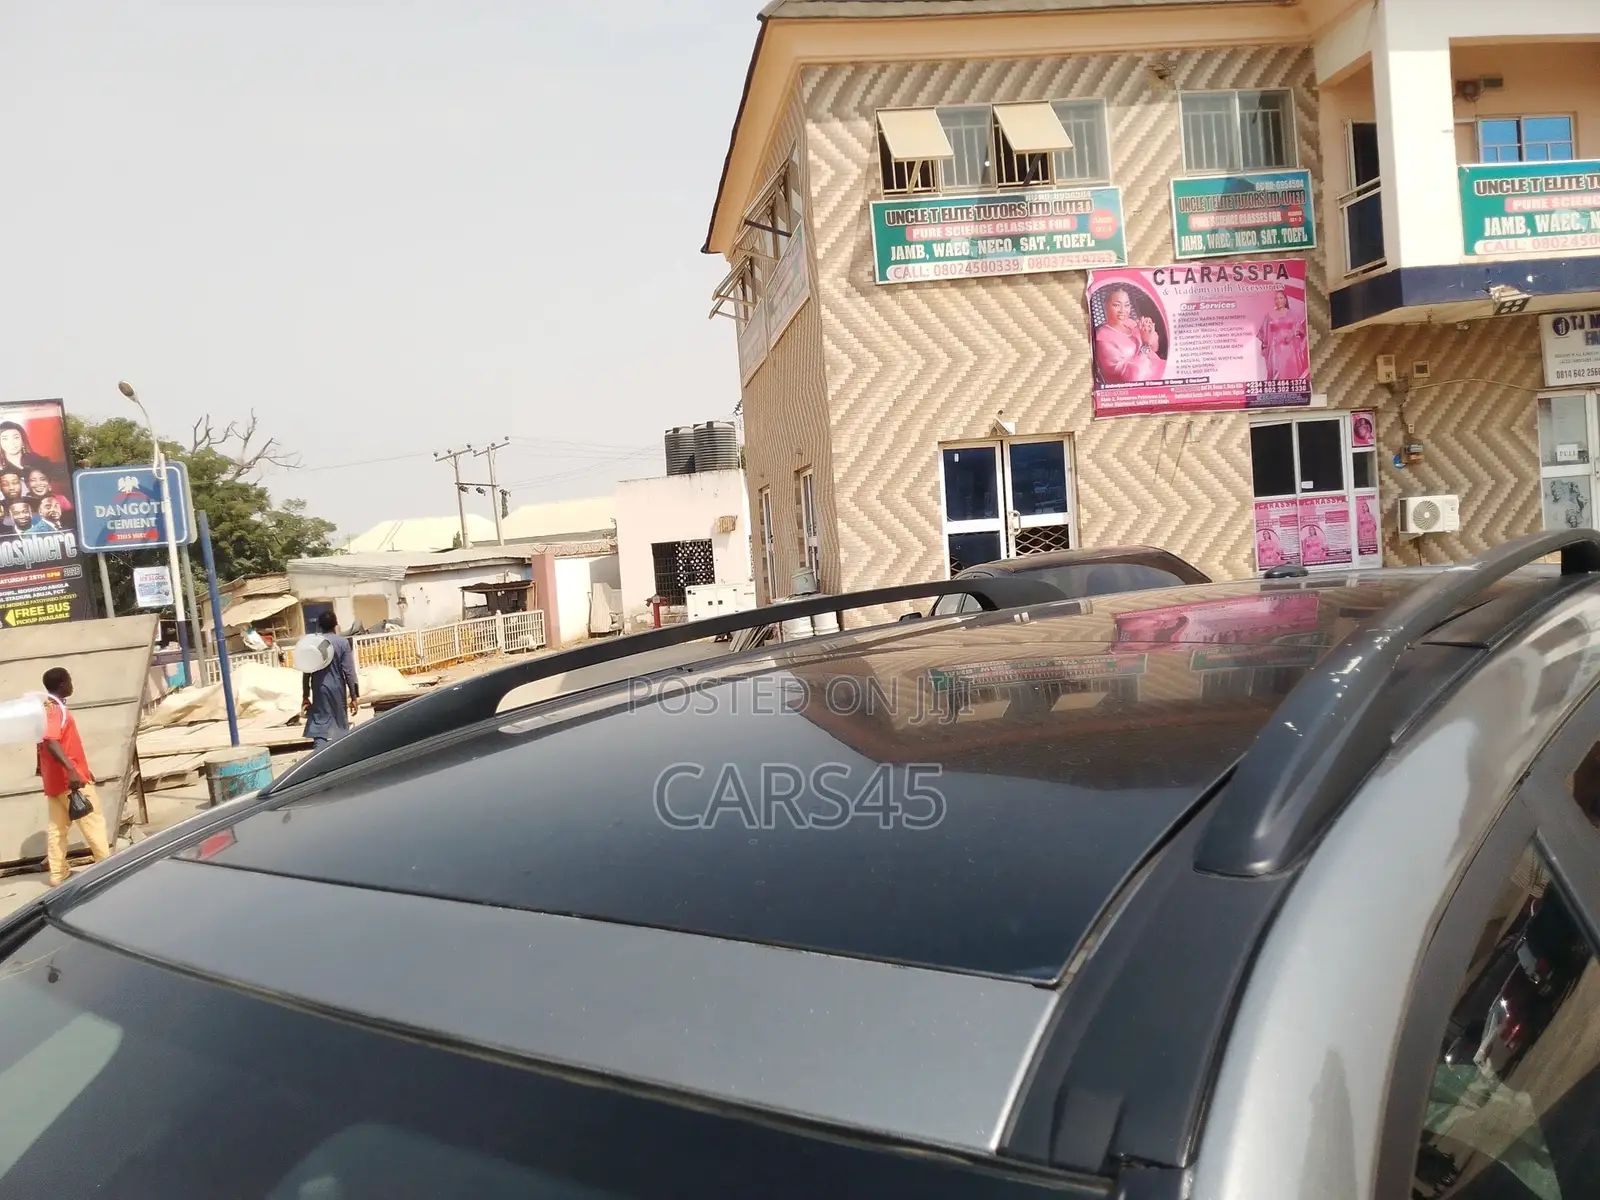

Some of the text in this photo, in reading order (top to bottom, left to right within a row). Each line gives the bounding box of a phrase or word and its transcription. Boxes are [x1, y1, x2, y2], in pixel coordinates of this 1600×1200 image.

[1475, 178, 1528, 196] UNCLE
[1529, 177, 1541, 193] T
[1543, 174, 1586, 192] ELITE
[1178, 196, 1205, 213] UNCLE
[1205, 195, 1211, 211] T
[1212, 193, 1234, 211] ELITE
[1234, 190, 1266, 210] TUTORS
[1512, 198, 1550, 210] PURE
[886, 209, 929, 226] UNCLE
[930, 208, 939, 223] T
[941, 206, 974, 222] ELITE
[974, 202, 1028, 220] TUTORS
[1028, 200, 1051, 216] LTD
[1210, 213, 1238, 226] SCIENCE
[1239, 211, 1267, 225] CLASSES
[1268, 211, 1282, 222] FOR
[912, 218, 1071, 239] PURE SCIENCE CLASSES FOR
[1484, 215, 1531, 236] JAMB,
[1535, 211, 1586, 233] WAEC,
[890, 233, 1096, 261] JAMB, WAEC, NECO, SAT, TOEFL
[1181, 234, 1206, 252] JAMB,
[1235, 230, 1259, 247] NECO,
[1260, 229, 1280, 245] SAT,
[1281, 226, 1308, 243] TOEFL
[1483, 239, 1526, 253] CALL:
[893, 263, 930, 279] CALL:
[1153, 263, 1289, 286] CLARASSPA
[1174, 285, 1211, 297] Academy
[1213, 283, 1233, 294] with
[1180, 301, 1236, 311] Our Services
[1570, 314, 1585, 331] TJ
[1556, 369, 1572, 379] 0814
[1573, 368, 1585, 378] 642
[107, 517, 157, 530] CEMENT
[15, 602, 71, 619] FREE BUS
[16, 612, 70, 626] PICKUP AVAILABLE
